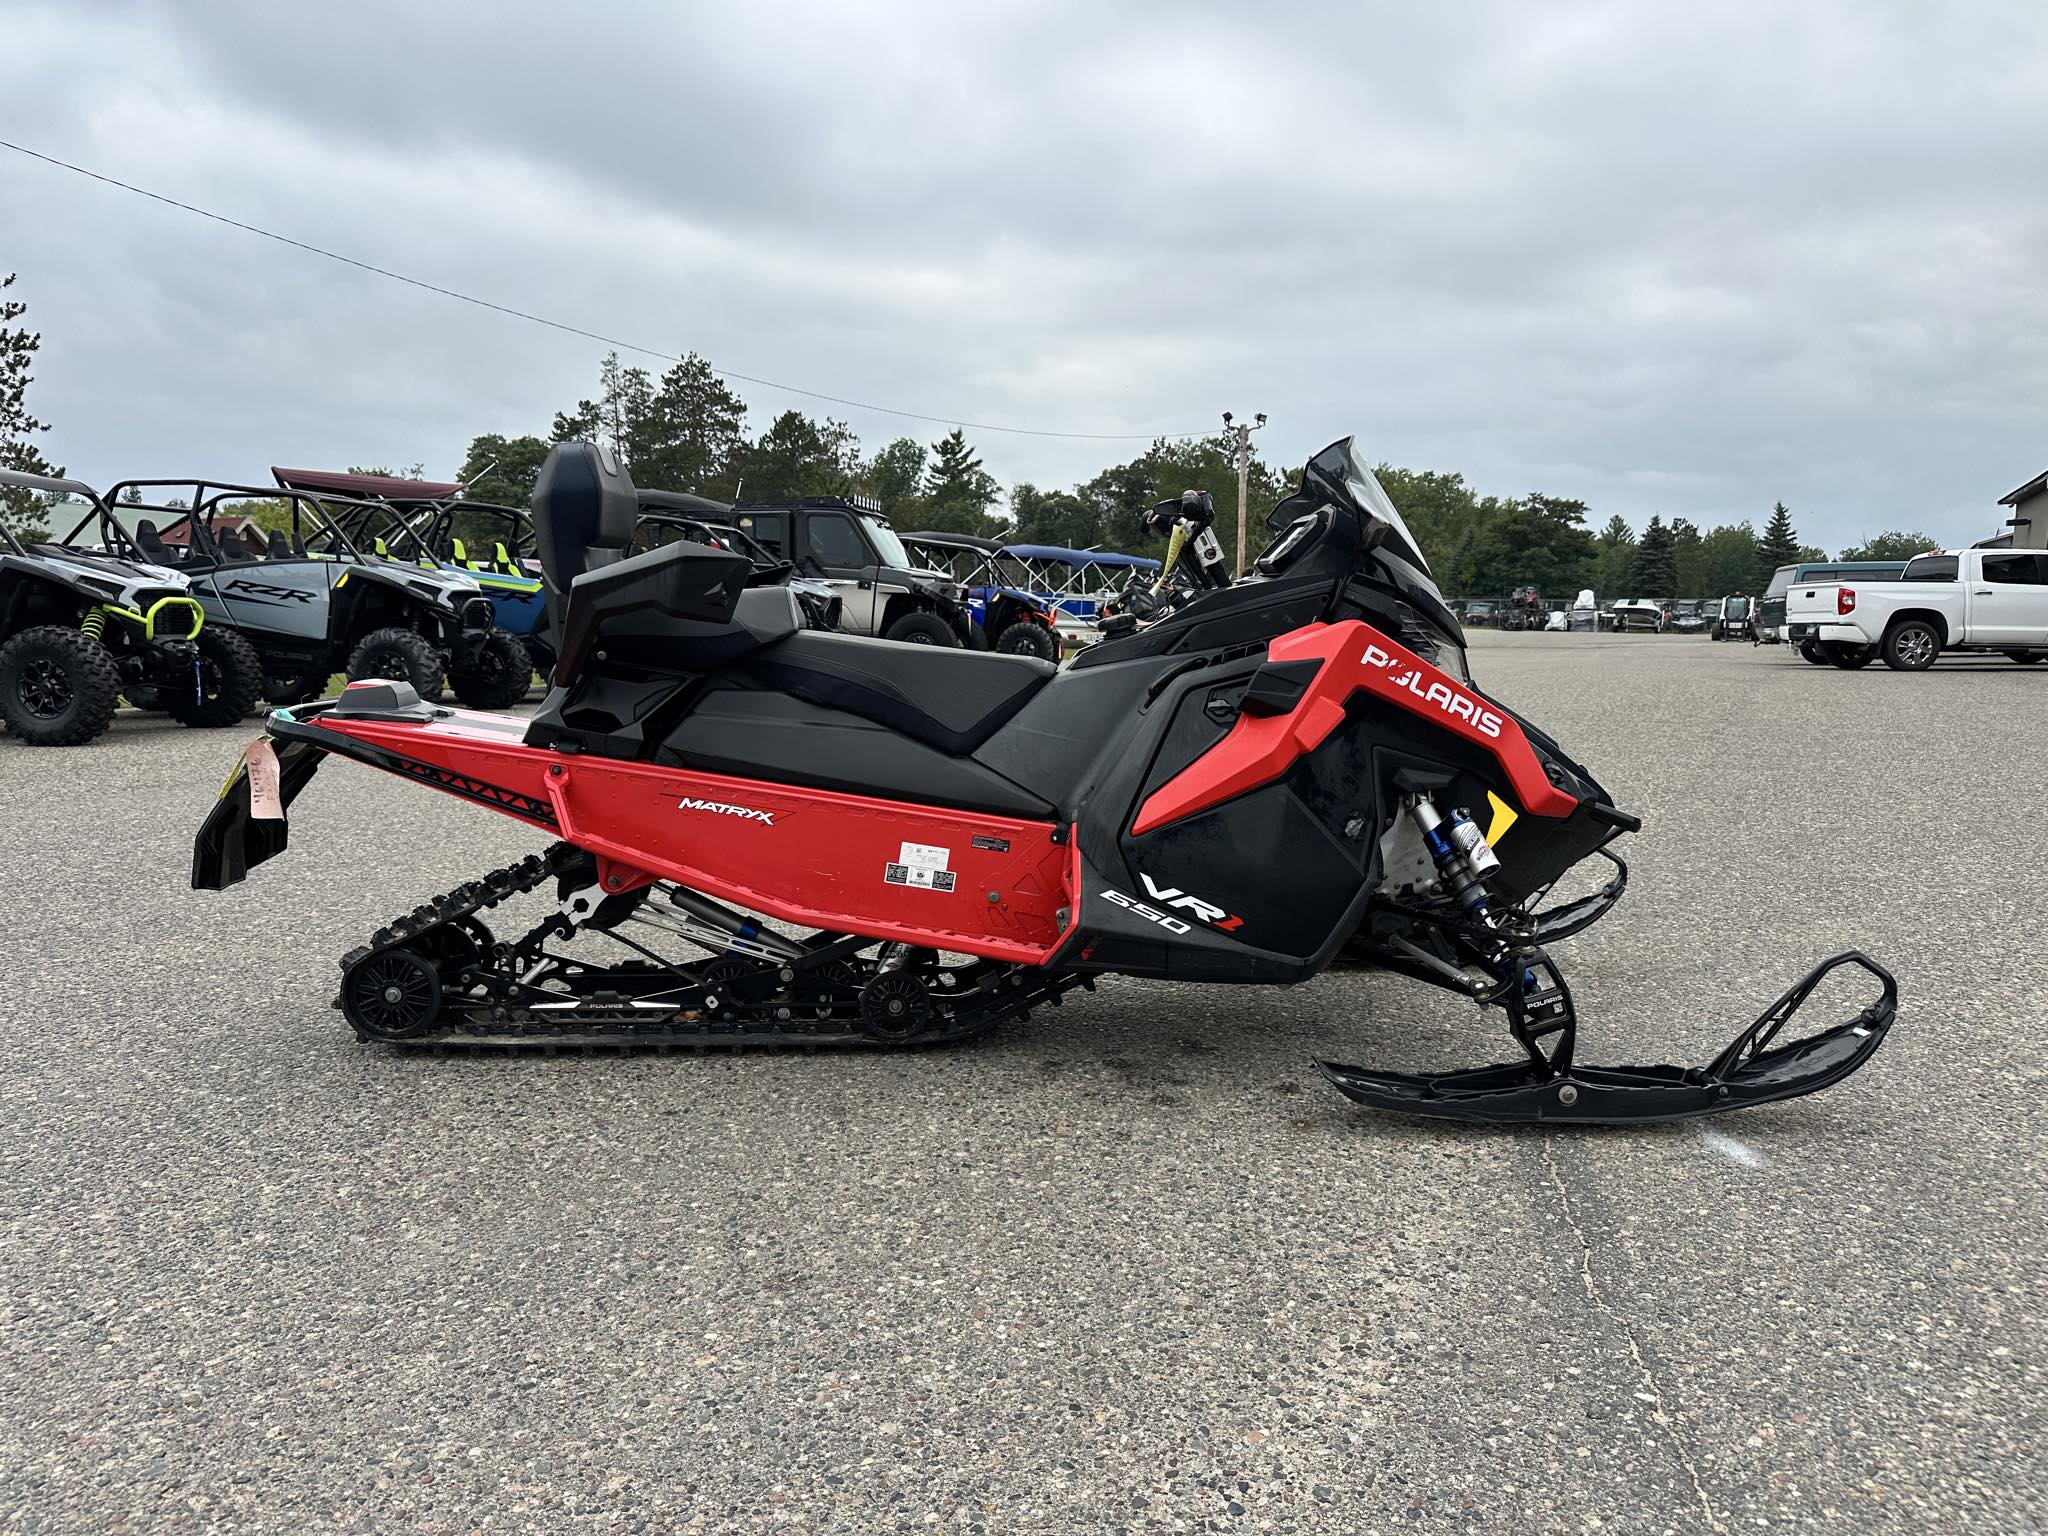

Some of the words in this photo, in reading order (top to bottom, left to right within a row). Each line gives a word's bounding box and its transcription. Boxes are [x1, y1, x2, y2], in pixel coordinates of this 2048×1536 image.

[223, 579, 318, 605] RZR
[1360, 644, 1503, 738] POLARIS
[677, 797, 775, 826] MATRYX
[1099, 889, 1192, 935] 650
[1526, 994, 1564, 1010] POLARIS
